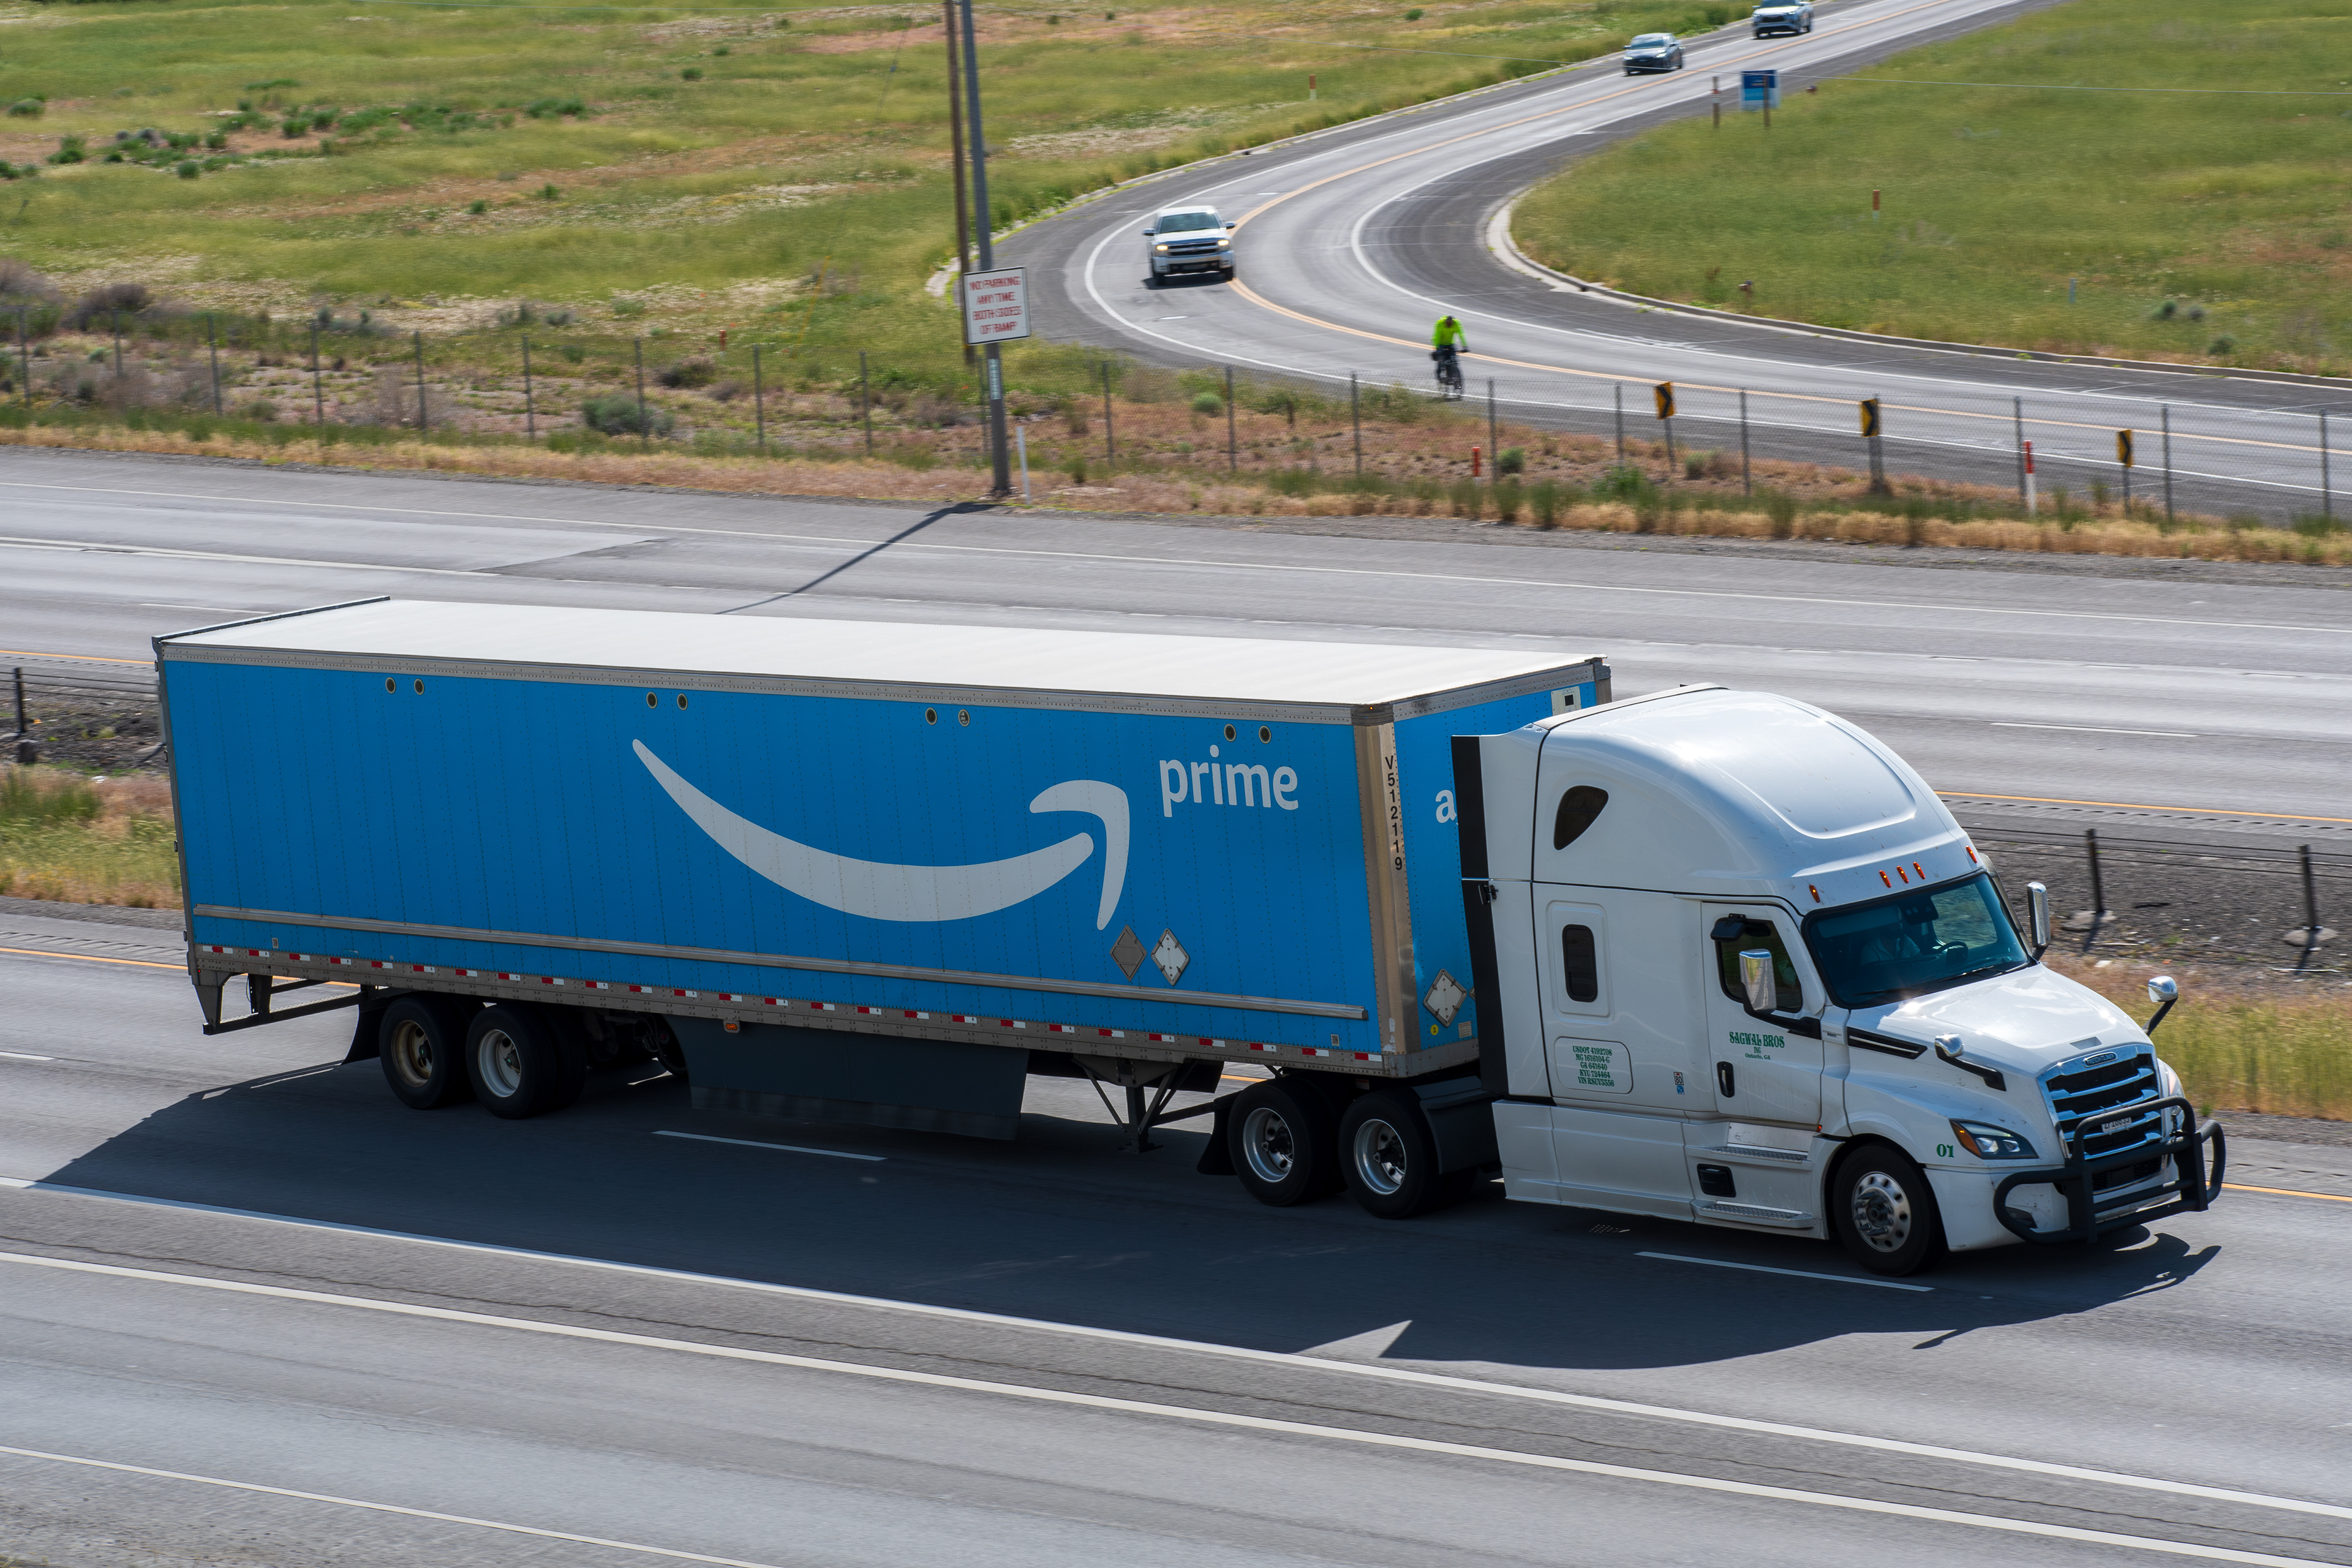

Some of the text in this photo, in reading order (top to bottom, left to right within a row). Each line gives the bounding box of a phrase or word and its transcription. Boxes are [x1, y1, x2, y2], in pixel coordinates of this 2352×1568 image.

[969, 276, 1022, 291] NO PARKING
[973, 306, 1023, 320] BOTH SIDES
[992, 321, 1017, 334] RAMP
[1159, 744, 1298, 818] prime
[1385, 755, 1403, 870] V512119
[1729, 1031, 1785, 1048] SAGWAL BROS
[1937, 1144, 1954, 1158] 01
